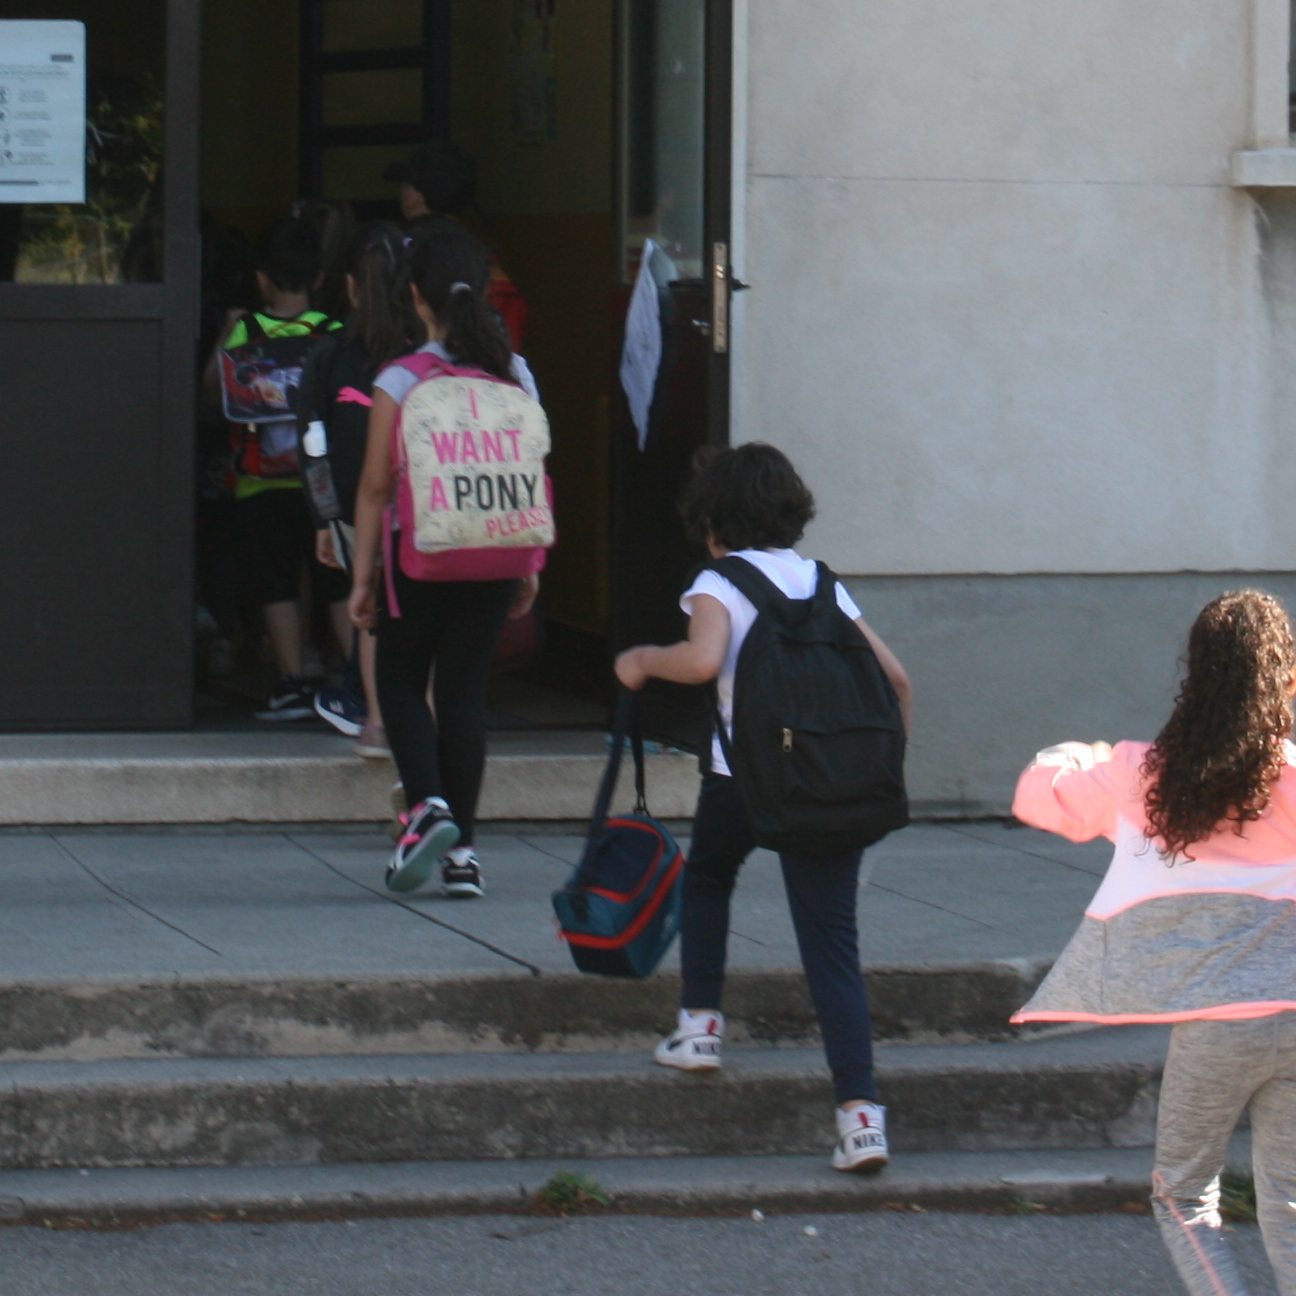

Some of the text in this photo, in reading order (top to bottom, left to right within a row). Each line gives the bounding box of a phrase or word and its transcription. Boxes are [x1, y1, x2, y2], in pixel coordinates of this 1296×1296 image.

[468, 386, 479, 420] I
[430, 429, 523, 465] WANT
[429, 473, 537, 512] A PONY
